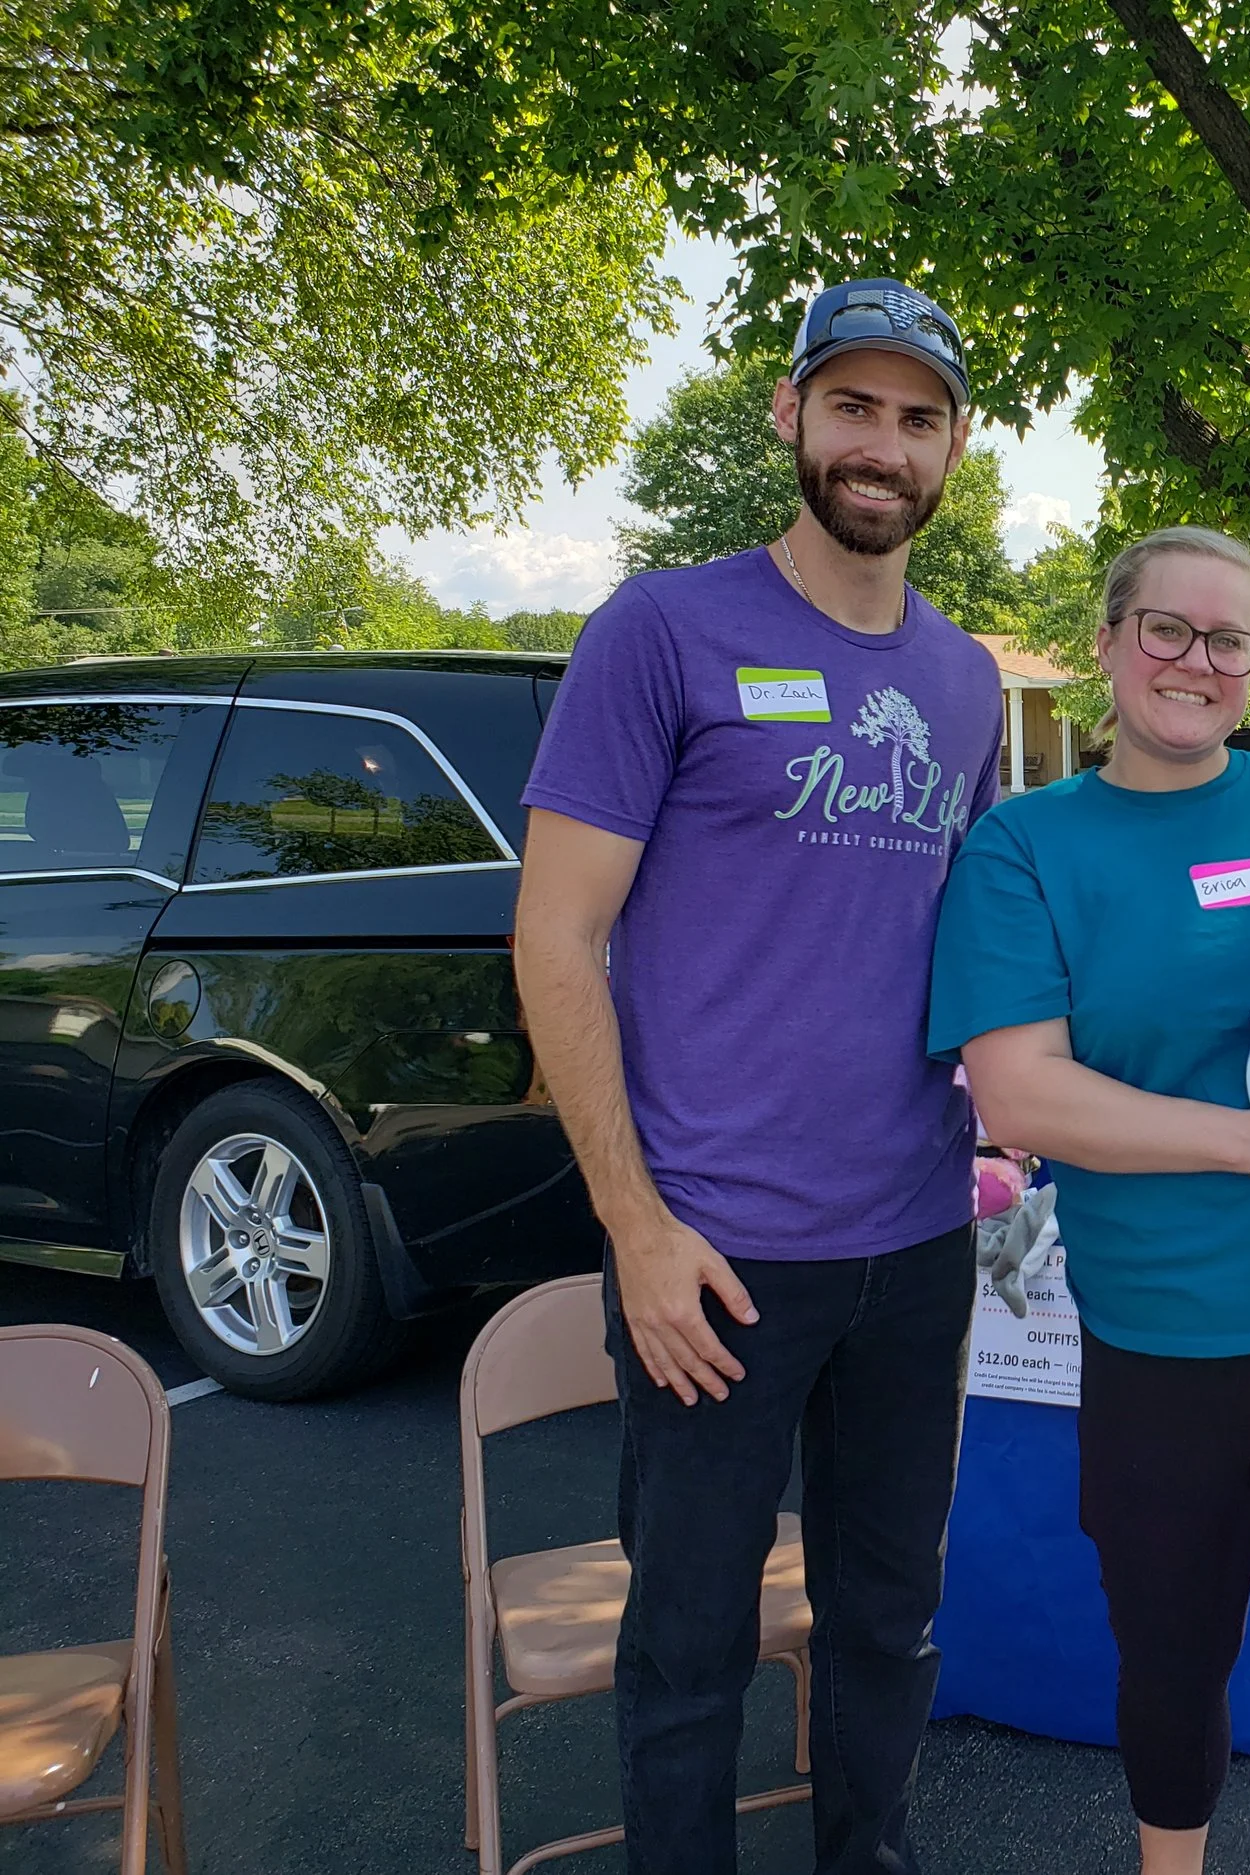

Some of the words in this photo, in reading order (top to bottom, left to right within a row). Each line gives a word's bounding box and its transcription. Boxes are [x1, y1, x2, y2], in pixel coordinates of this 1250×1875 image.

[748, 685, 775, 700] Dr.
[774, 746, 895, 823] New
[902, 761, 968, 843] Life
[798, 831, 861, 846] FAMILY
[1027, 1289, 1055, 1302] each
[1027, 1331, 1079, 1346] OUTFITS
[978, 1350, 1019, 1367] $12.00
[1022, 1357, 1050, 1370] each
